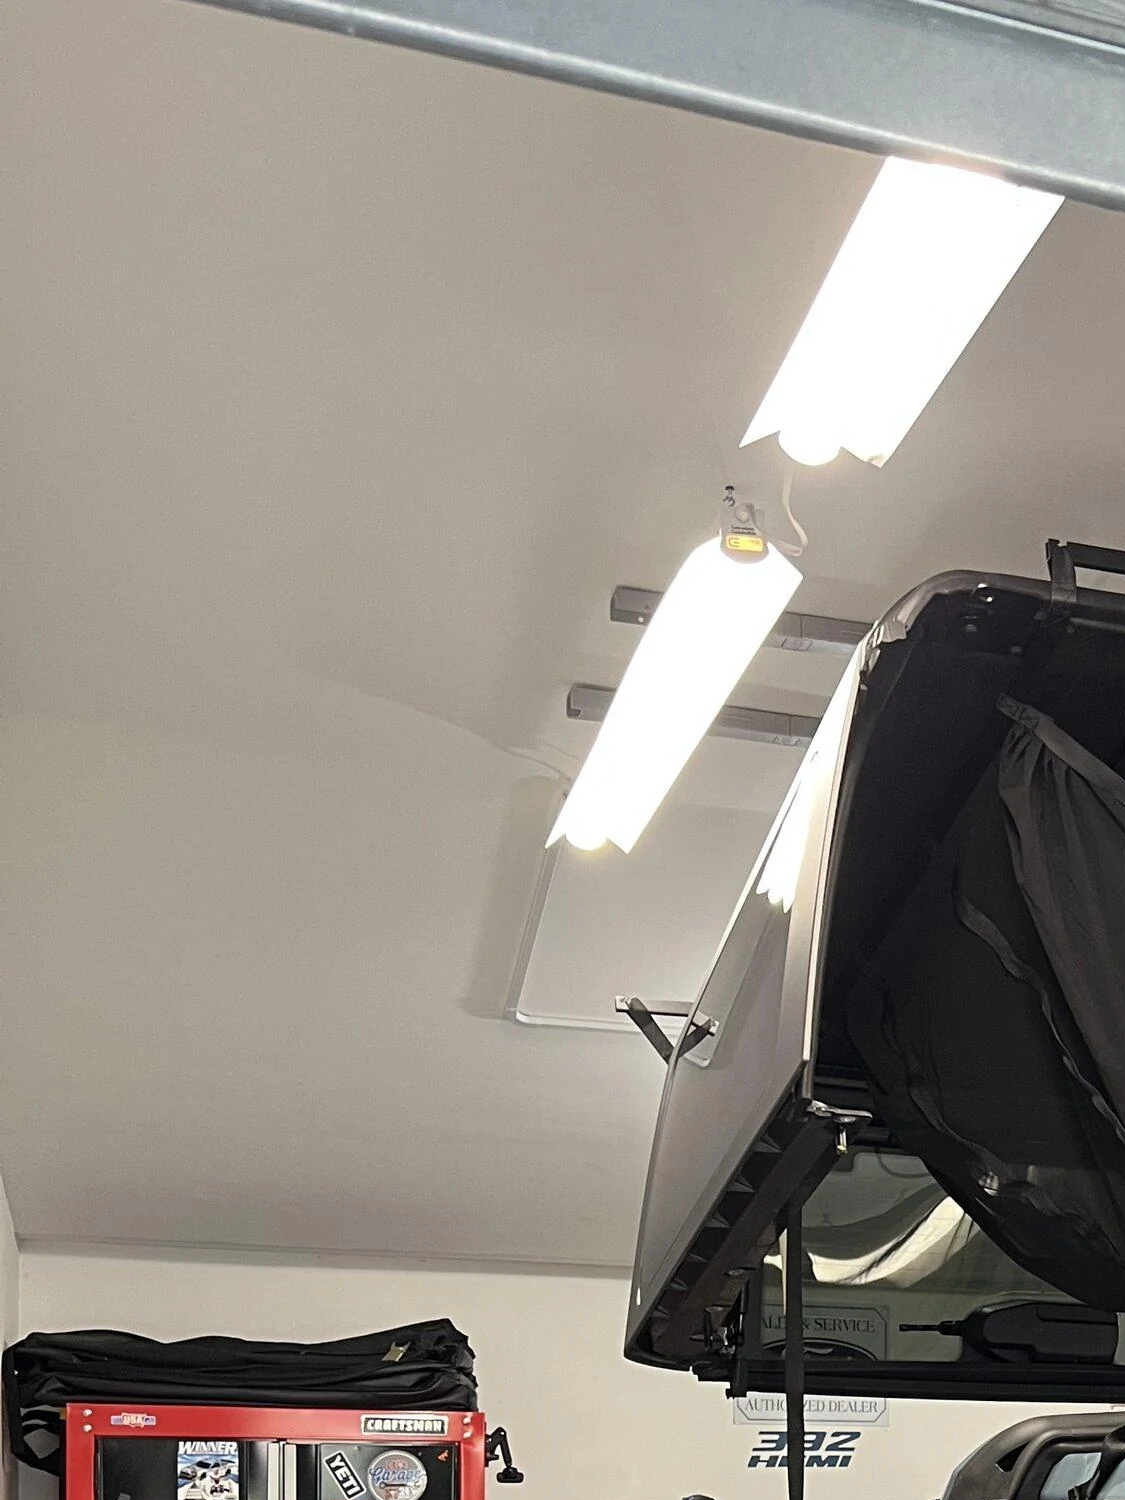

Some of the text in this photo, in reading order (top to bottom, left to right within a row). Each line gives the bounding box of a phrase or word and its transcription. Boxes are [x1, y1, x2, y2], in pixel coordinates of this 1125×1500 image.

[813, 1317, 876, 1333] SERVICE
[828, 1399, 878, 1413] DEALER
[124, 1415, 143, 1425] USA
[366, 1419, 442, 1432] CRAFTSMAN
[178, 1441, 238, 1455] WINNER
[329, 1454, 361, 1497] YETI
